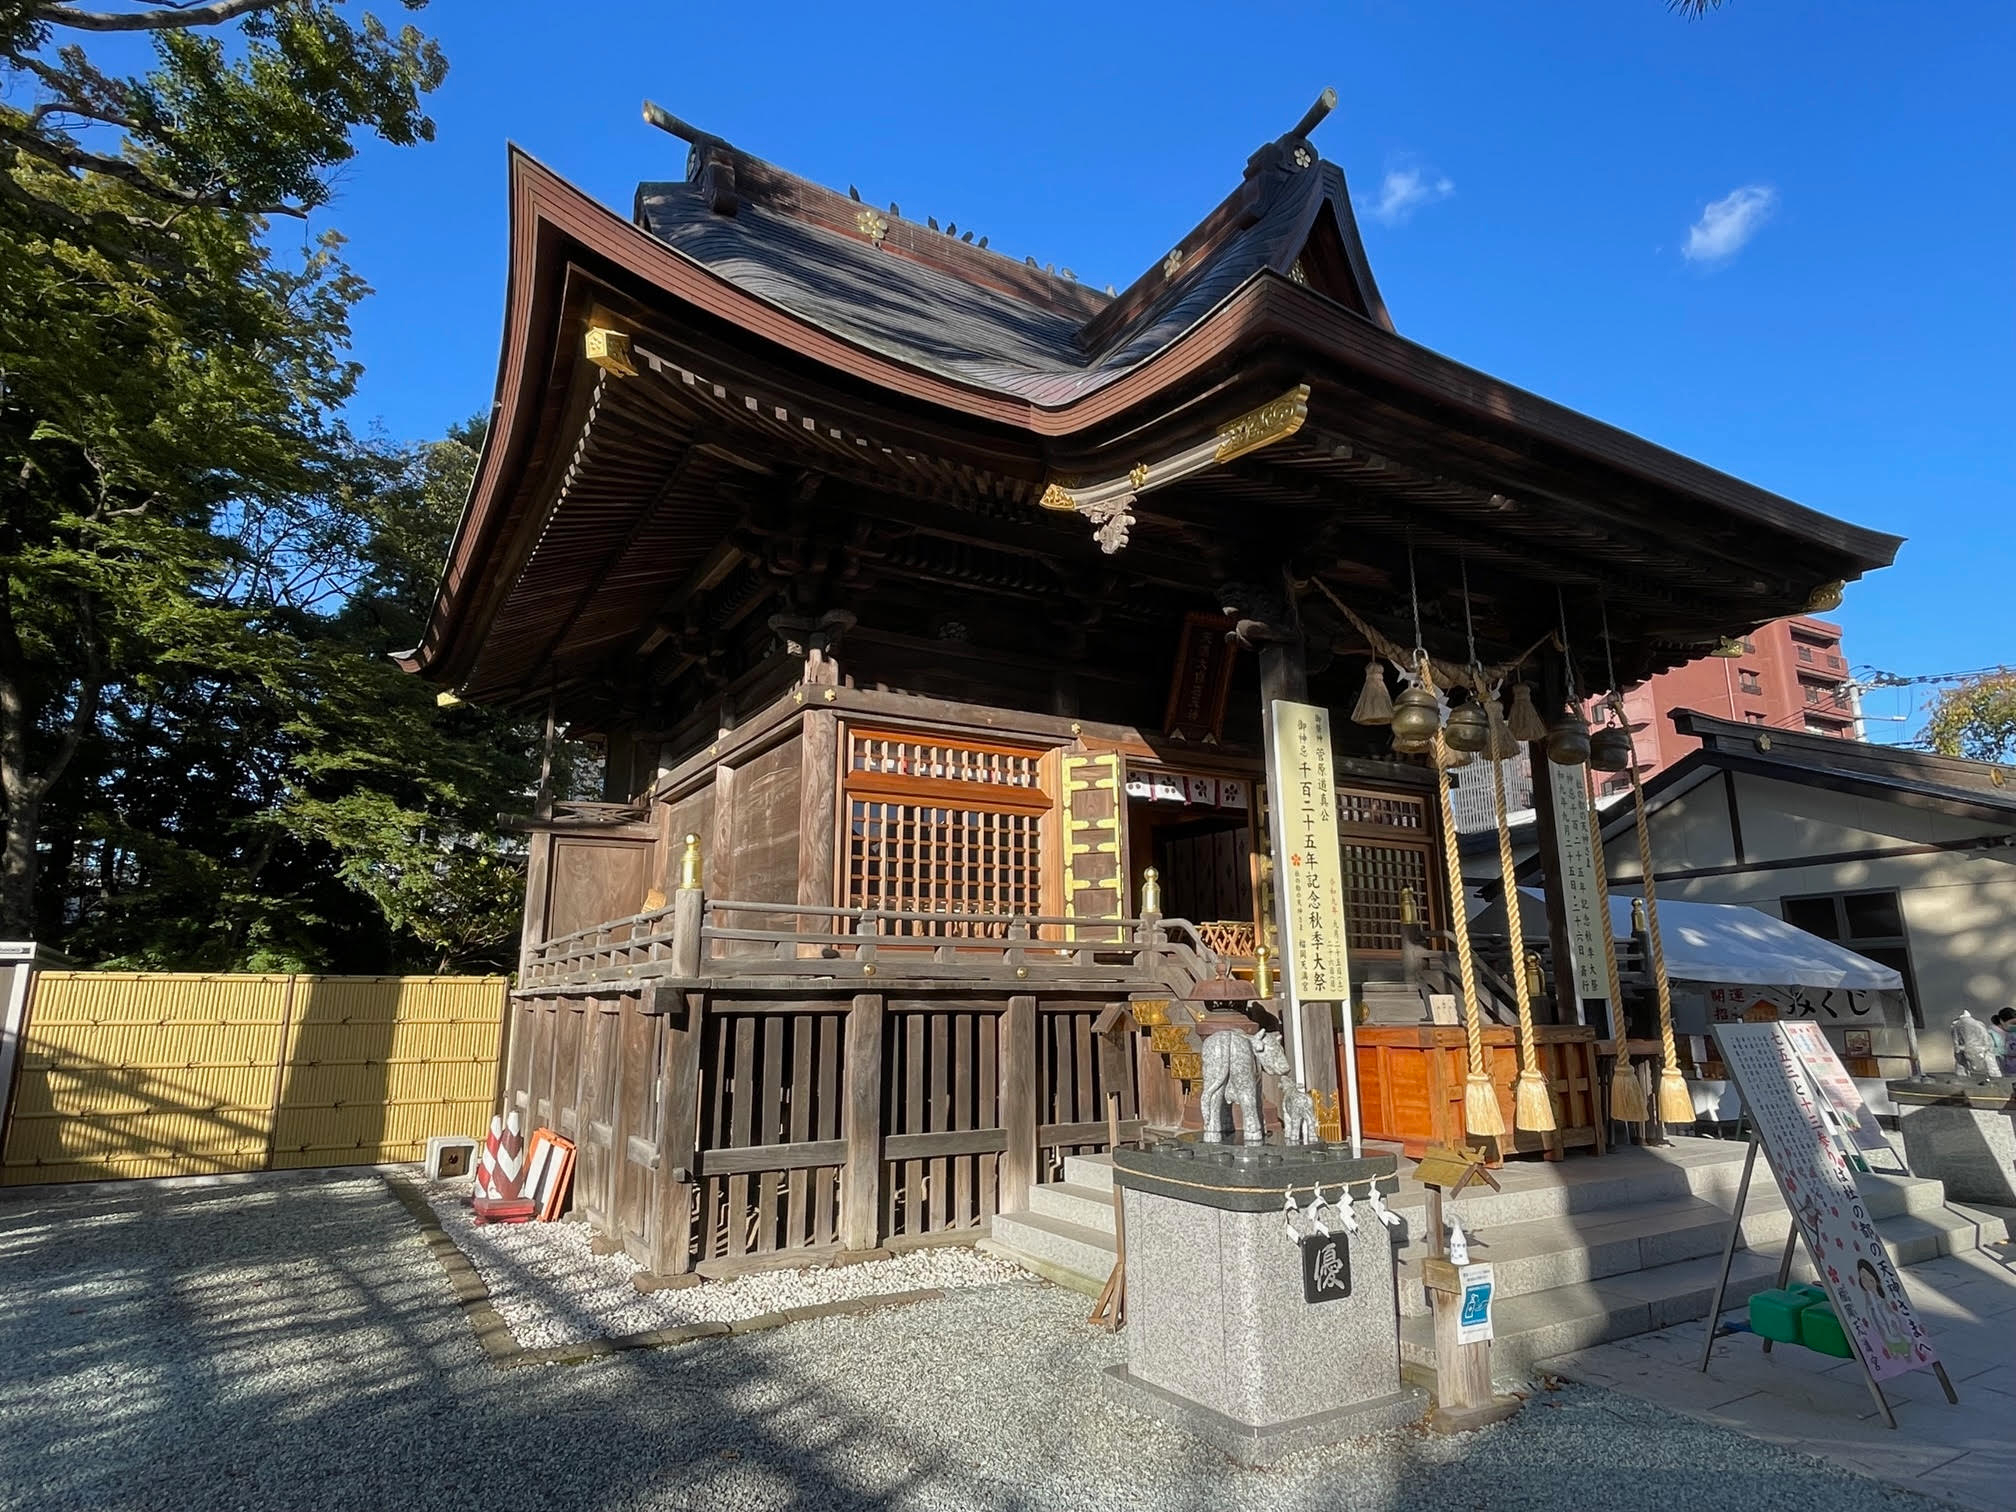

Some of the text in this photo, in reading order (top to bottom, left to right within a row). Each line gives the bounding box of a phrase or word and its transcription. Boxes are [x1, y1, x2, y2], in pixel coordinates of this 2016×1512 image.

[1316, 747, 1329, 822] 菅原道真公
[1557, 770, 1584, 956] 和九年九月二十五日・二十六日
[1751, 988, 1871, 1018] みくじ
[1314, 1242, 1345, 1292] 優
